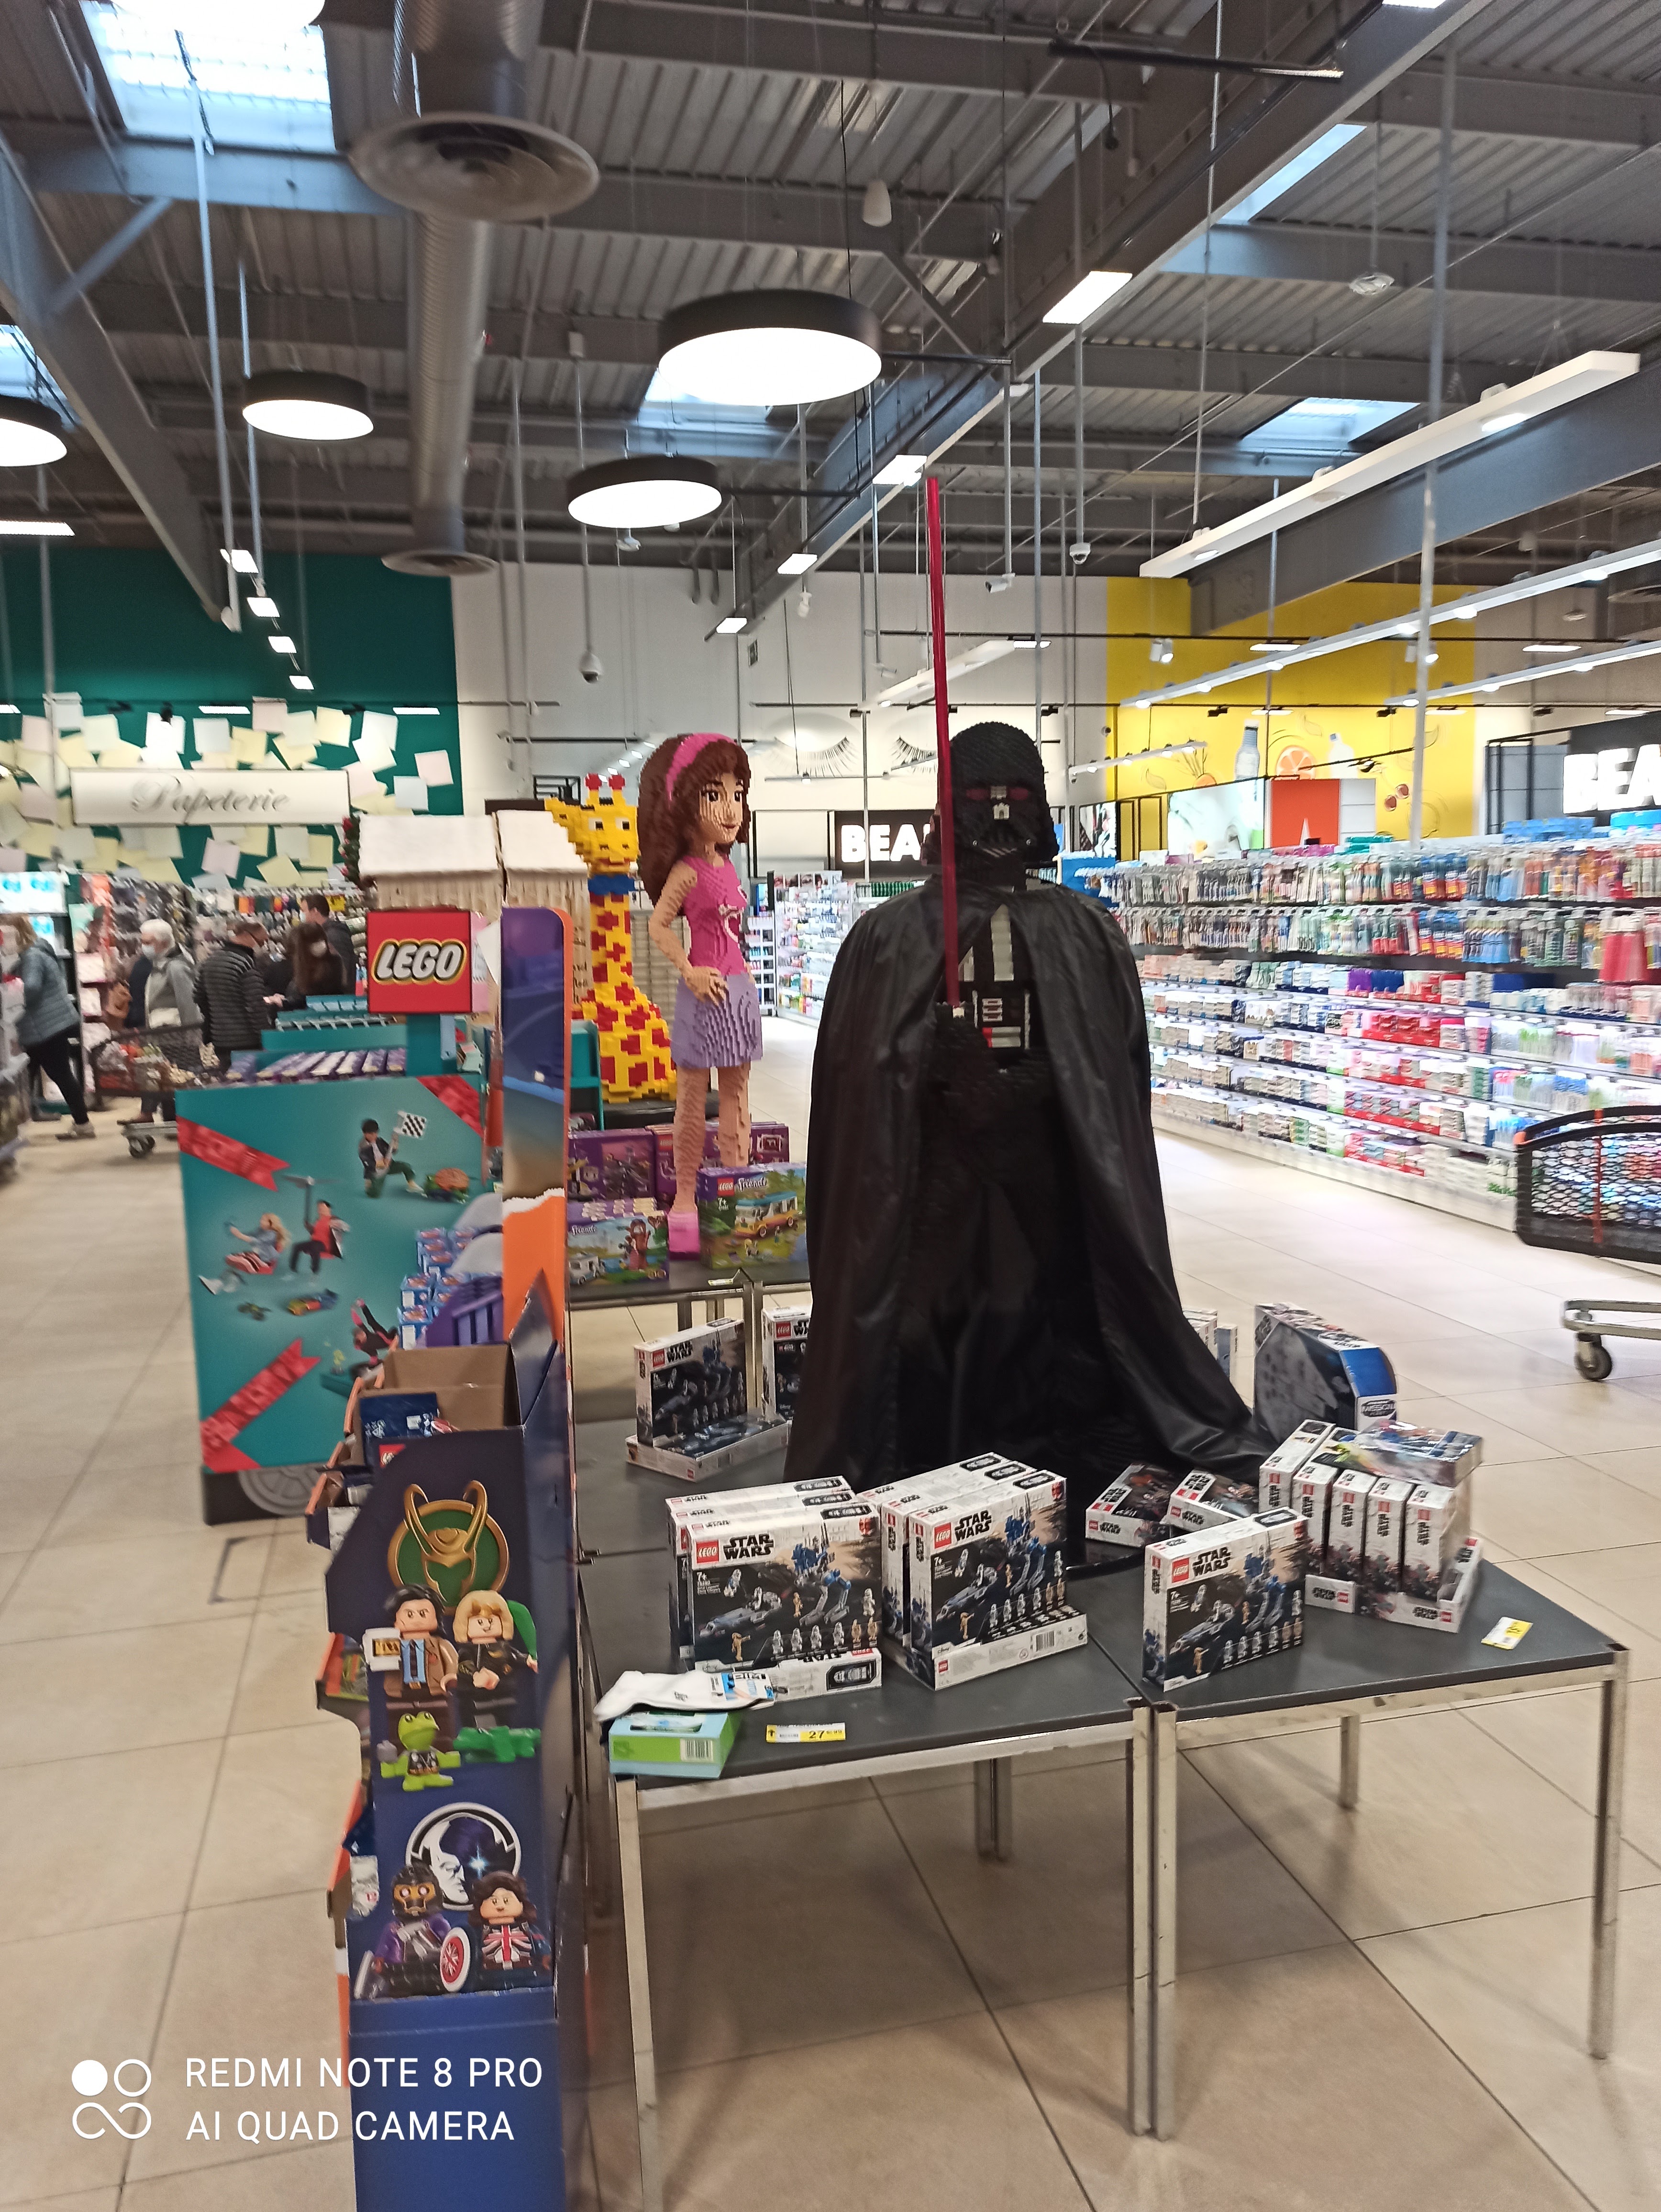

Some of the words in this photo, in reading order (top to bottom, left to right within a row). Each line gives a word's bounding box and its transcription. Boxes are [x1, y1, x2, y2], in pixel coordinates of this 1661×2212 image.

[132, 775, 289, 824] Papeterie
[374, 940, 464, 982] LEGO
[936, 1529, 951, 1542] LEGO
[954, 1510, 992, 1531] STAR
[955, 1519, 992, 1541] WARS
[697, 1546, 718, 1559] LEGO
[723, 1534, 774, 1548] STAR
[723, 1543, 774, 1560] WARS
[1174, 1564, 1189, 1576] LEGO
[1193, 1546, 1231, 1566] STAR
[1193, 1557, 1231, 1577] WARS
[809, 1730, 824, 1739] 27
